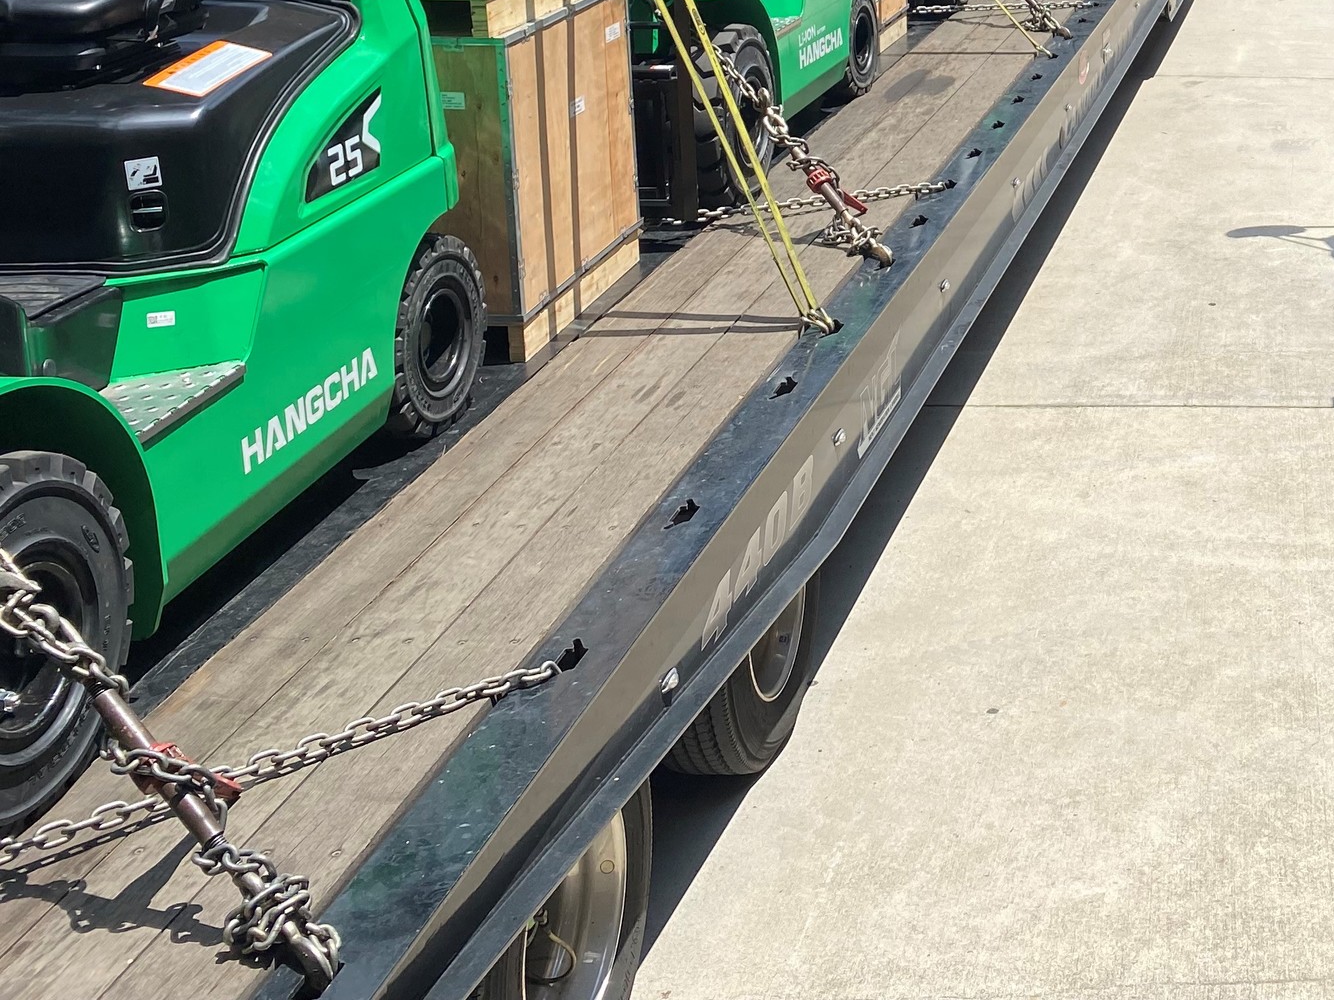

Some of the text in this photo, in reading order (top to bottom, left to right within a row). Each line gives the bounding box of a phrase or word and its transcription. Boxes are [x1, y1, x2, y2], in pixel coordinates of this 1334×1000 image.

[799, 27, 843, 70] HANGCHA
[327, 135, 363, 187] 25
[241, 347, 378, 475] HANGCHA
[701, 454, 814, 652] 440B
